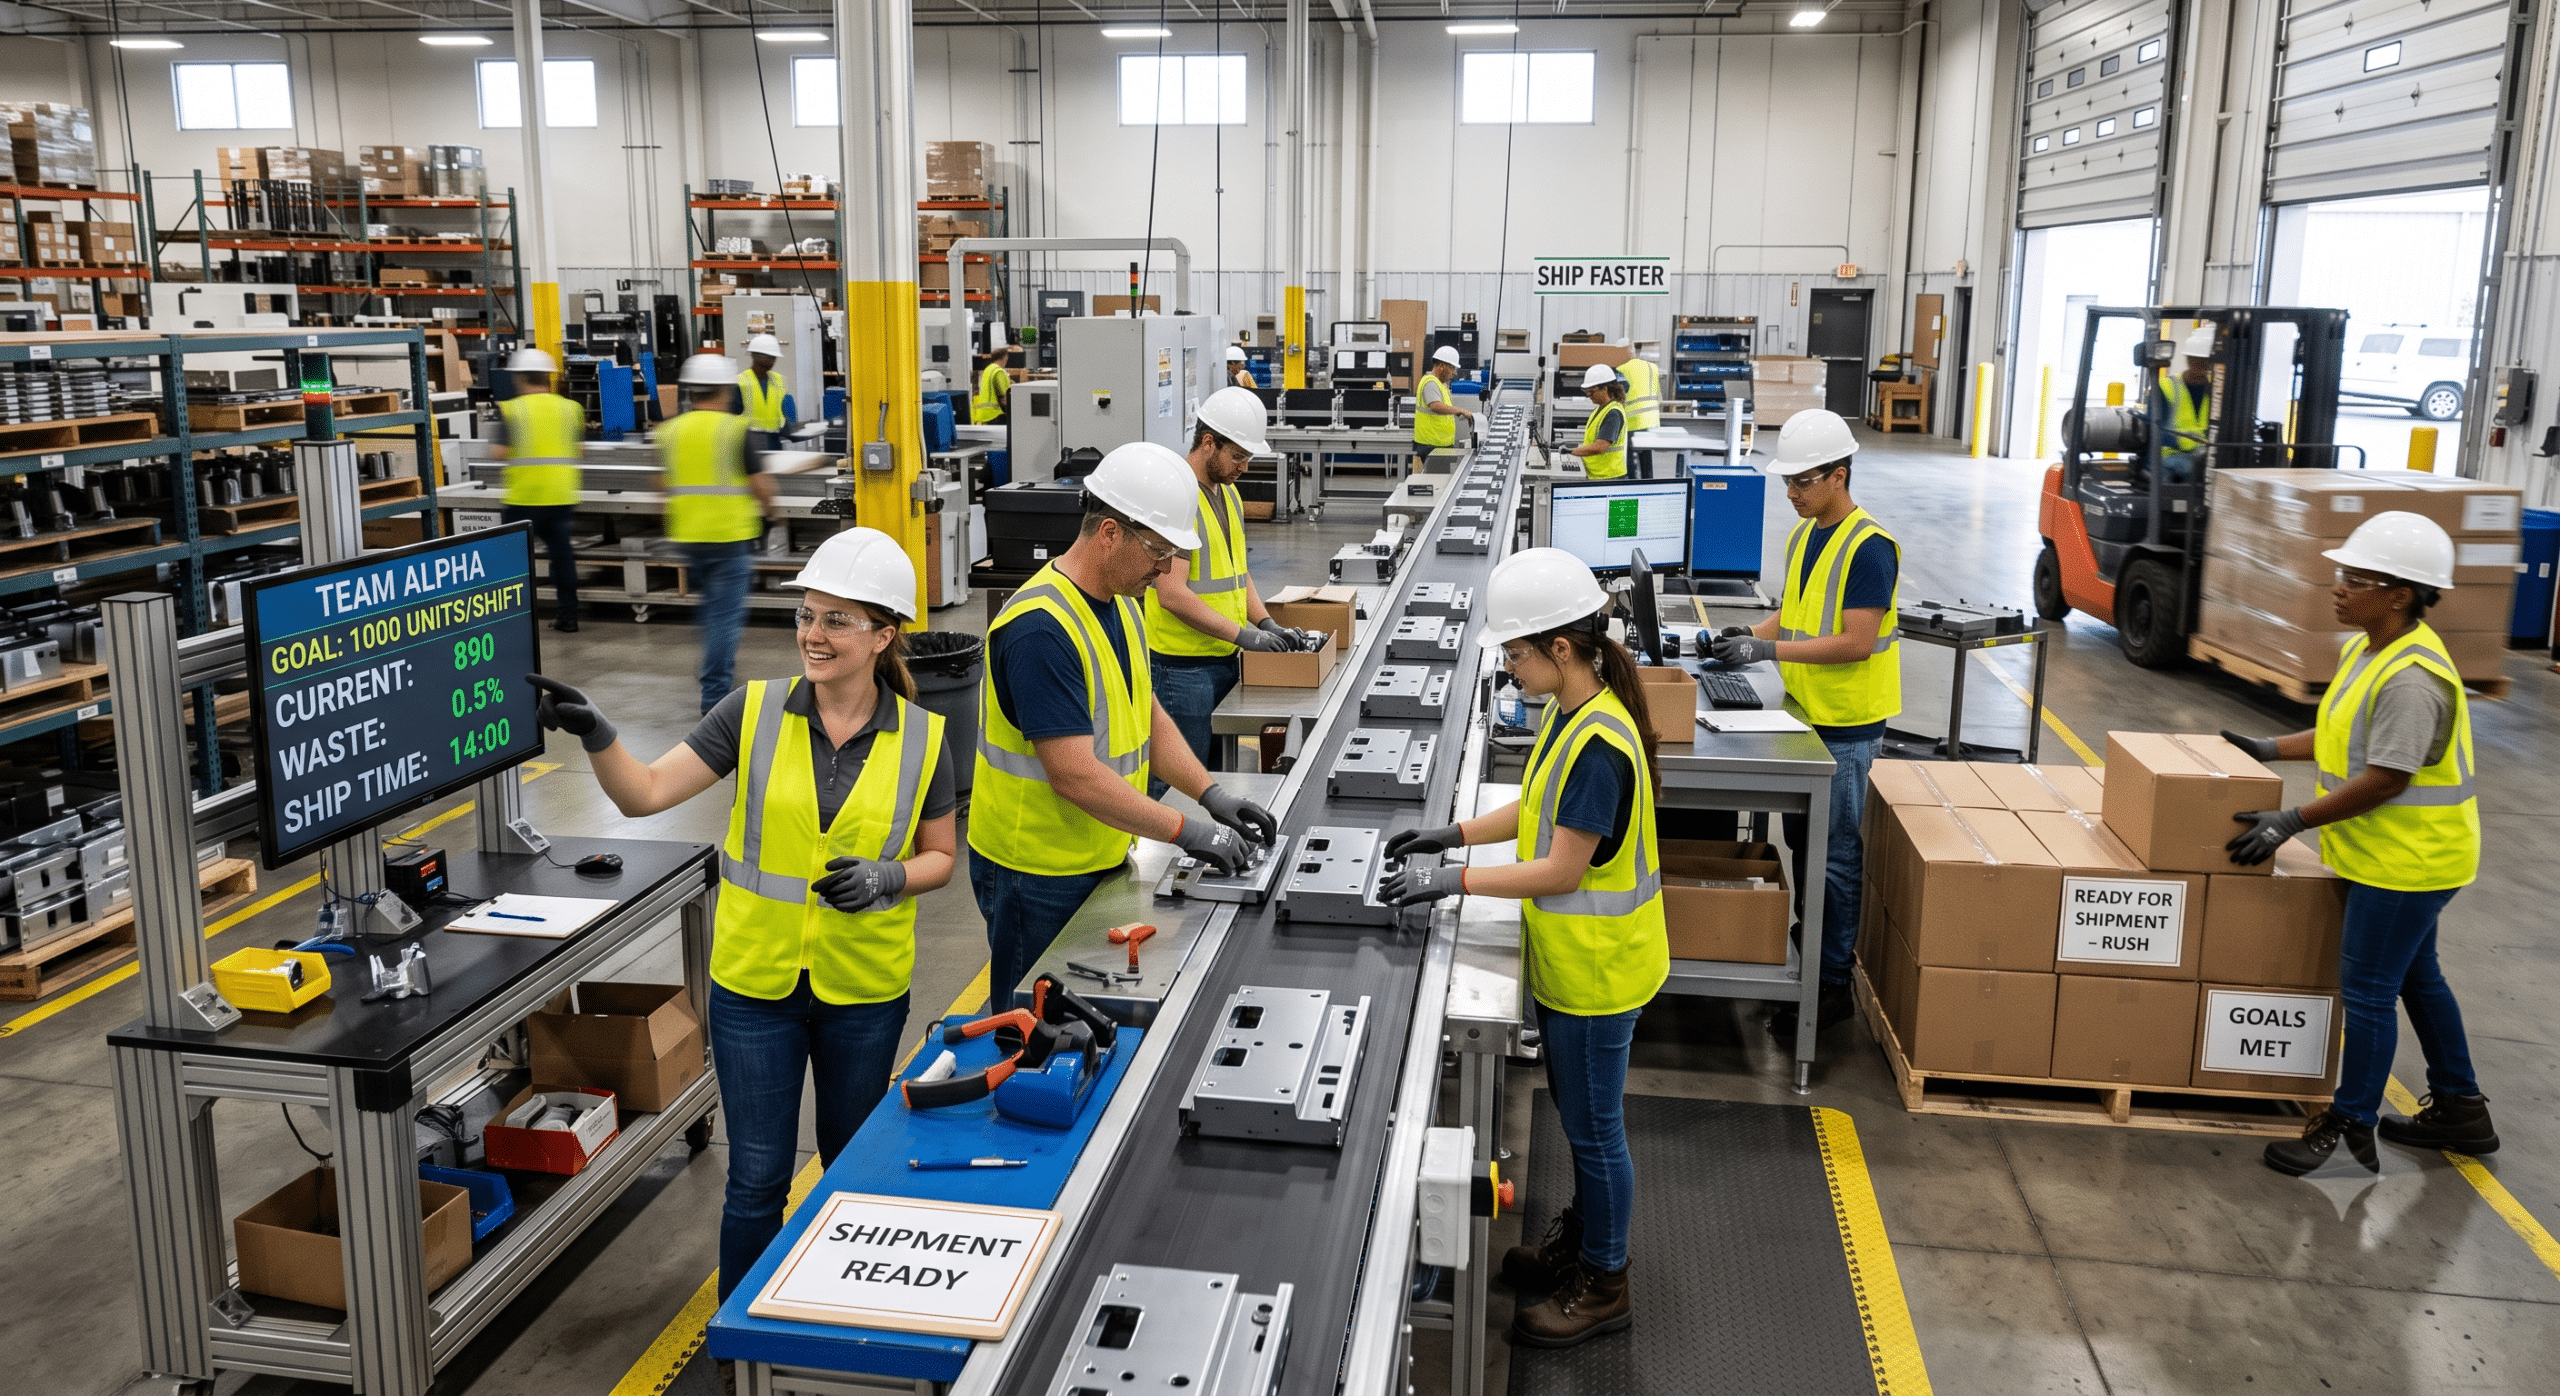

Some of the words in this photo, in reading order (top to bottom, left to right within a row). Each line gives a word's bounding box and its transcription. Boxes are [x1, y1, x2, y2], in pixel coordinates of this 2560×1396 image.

[1538, 265, 1584, 286] SHIP
[1590, 265, 1664, 286] FASTER
[315, 569, 395, 617] TEAM
[403, 550, 485, 597] ALPHA
[271, 637, 343, 674] GOAL:
[350, 616, 401, 652] 1000
[406, 583, 524, 636] UNITS/SHIFT
[275, 659, 414, 728] CURRENT:
[454, 632, 495, 671] 890
[278, 717, 387, 782] WASTE:
[451, 677, 504, 717] 0.5%
[284, 780, 352, 834] SHIP
[357, 751, 429, 802] TIME:
[450, 718, 510, 765] 14:00
[2075, 889, 2133, 905] READY
[2138, 892, 2173, 907] FOR
[2075, 911, 2169, 929] SHIPMENT
[2102, 935, 2149, 951] RUSH
[2229, 1007, 2306, 1028] GOALS
[2240, 1038, 2292, 1058] MET
[828, 1223, 1022, 1258] SHIPMENT
[840, 1260, 969, 1290] READY
